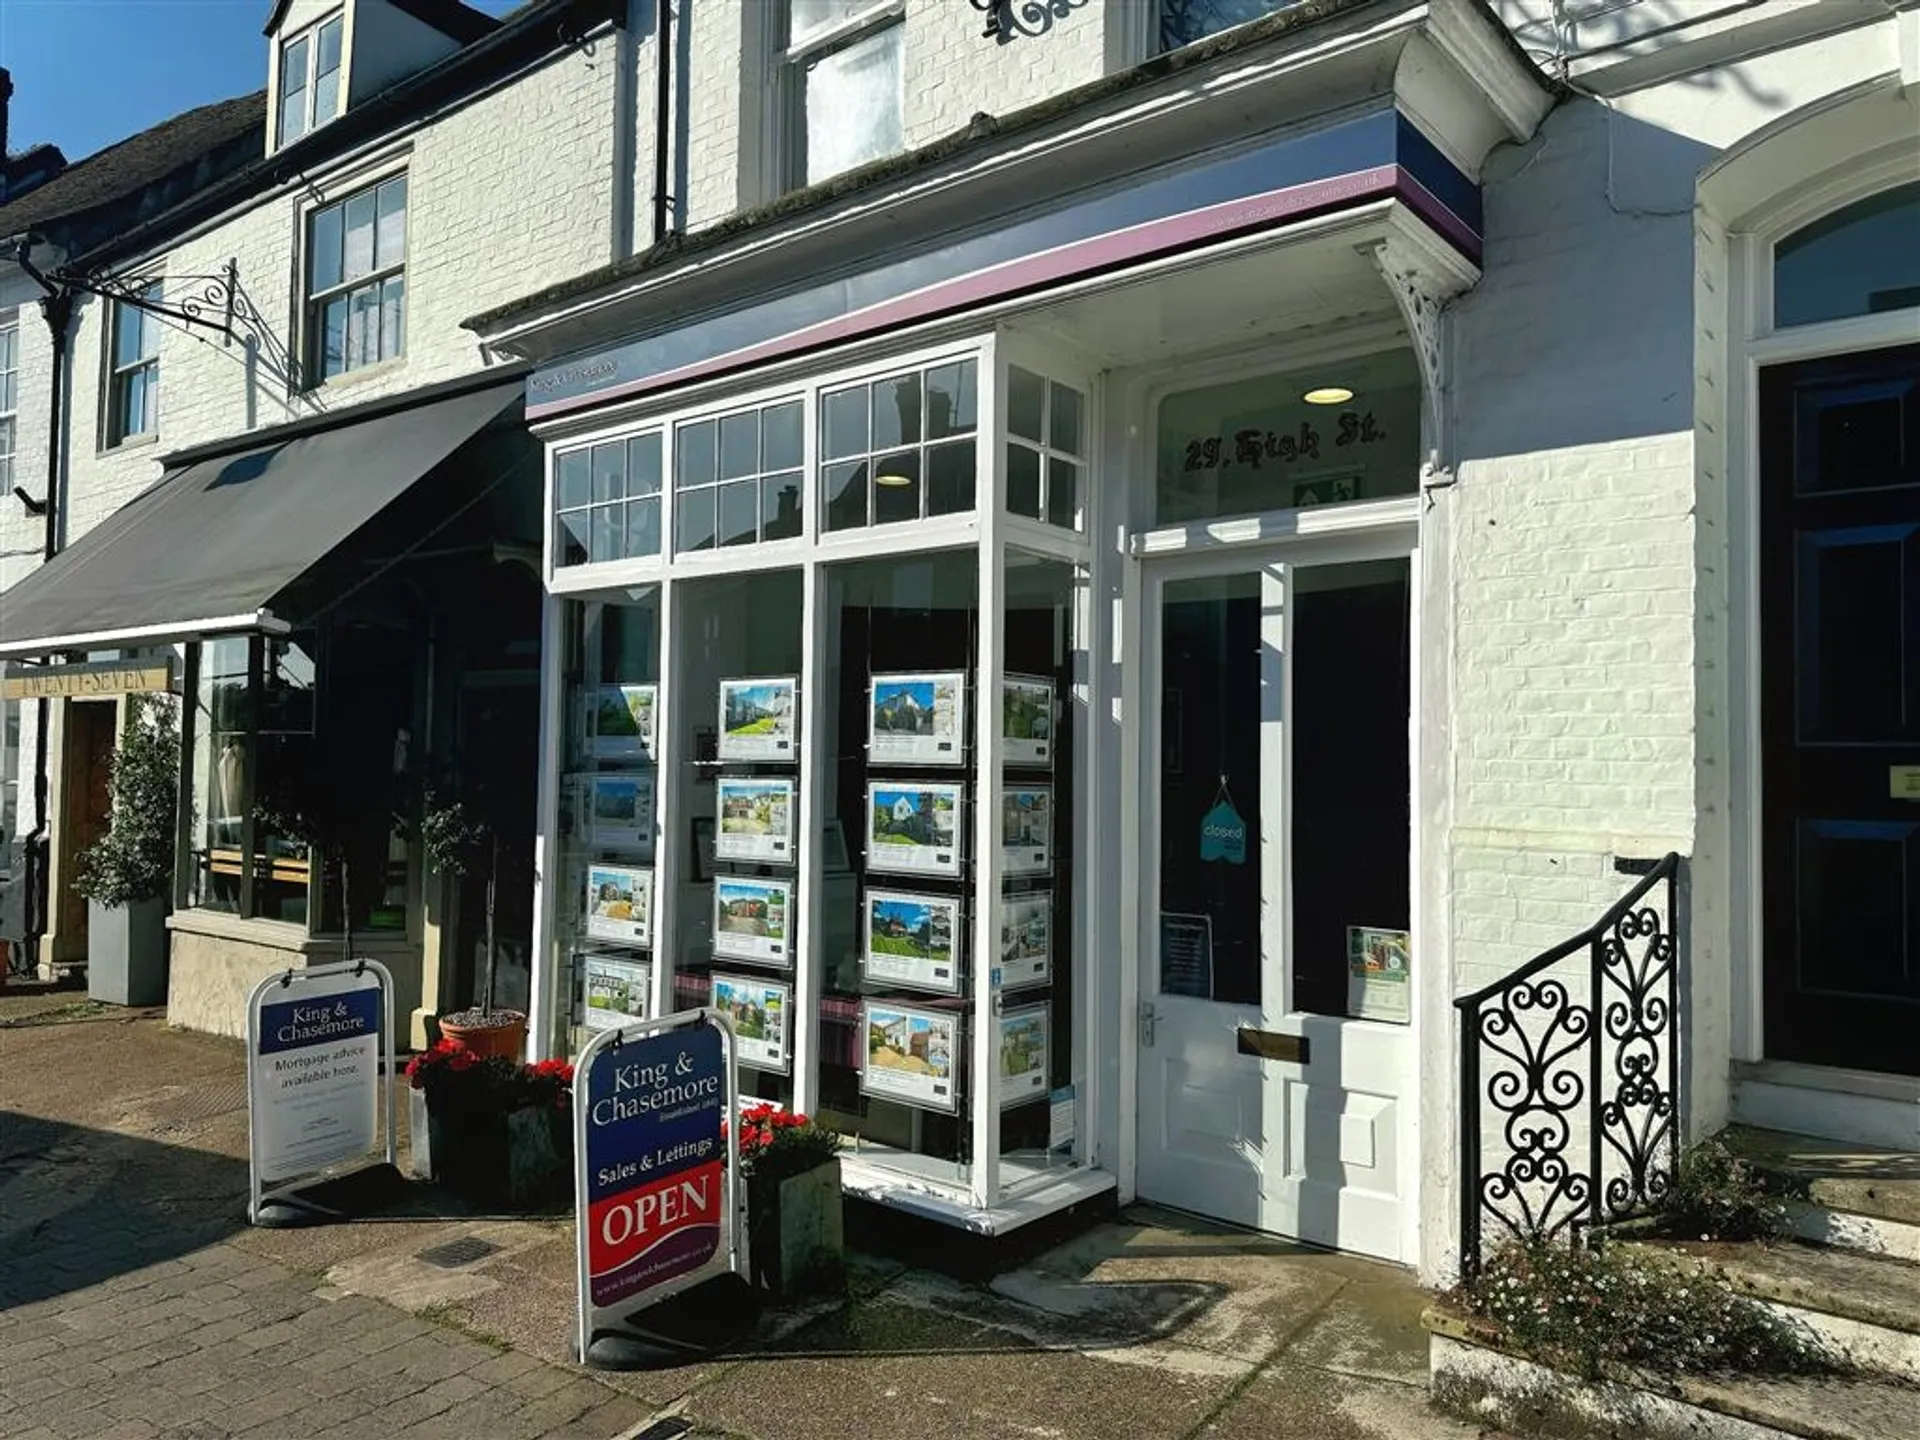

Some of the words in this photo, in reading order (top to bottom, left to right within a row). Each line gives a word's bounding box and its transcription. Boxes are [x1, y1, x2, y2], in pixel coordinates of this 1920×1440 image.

[1235, 421, 1321, 470] High
[1335, 411, 1388, 447] St.
[1203, 824, 1243, 839] closed
[292, 1006, 332, 1024] King
[334, 1000, 348, 1016] &
[277, 1016, 365, 1043] Chasemore
[275, 1054, 331, 1073] Mortgage
[332, 1046, 366, 1061] advice
[614, 1062, 669, 1093] King
[674, 1051, 694, 1076] &
[281, 1069, 331, 1089] available
[592, 1075, 719, 1127] Chasemore
[598, 1162, 637, 1187] Sales
[640, 1154, 654, 1172] &
[656, 1137, 713, 1166] Lettings
[602, 1174, 709, 1247] OPEN
